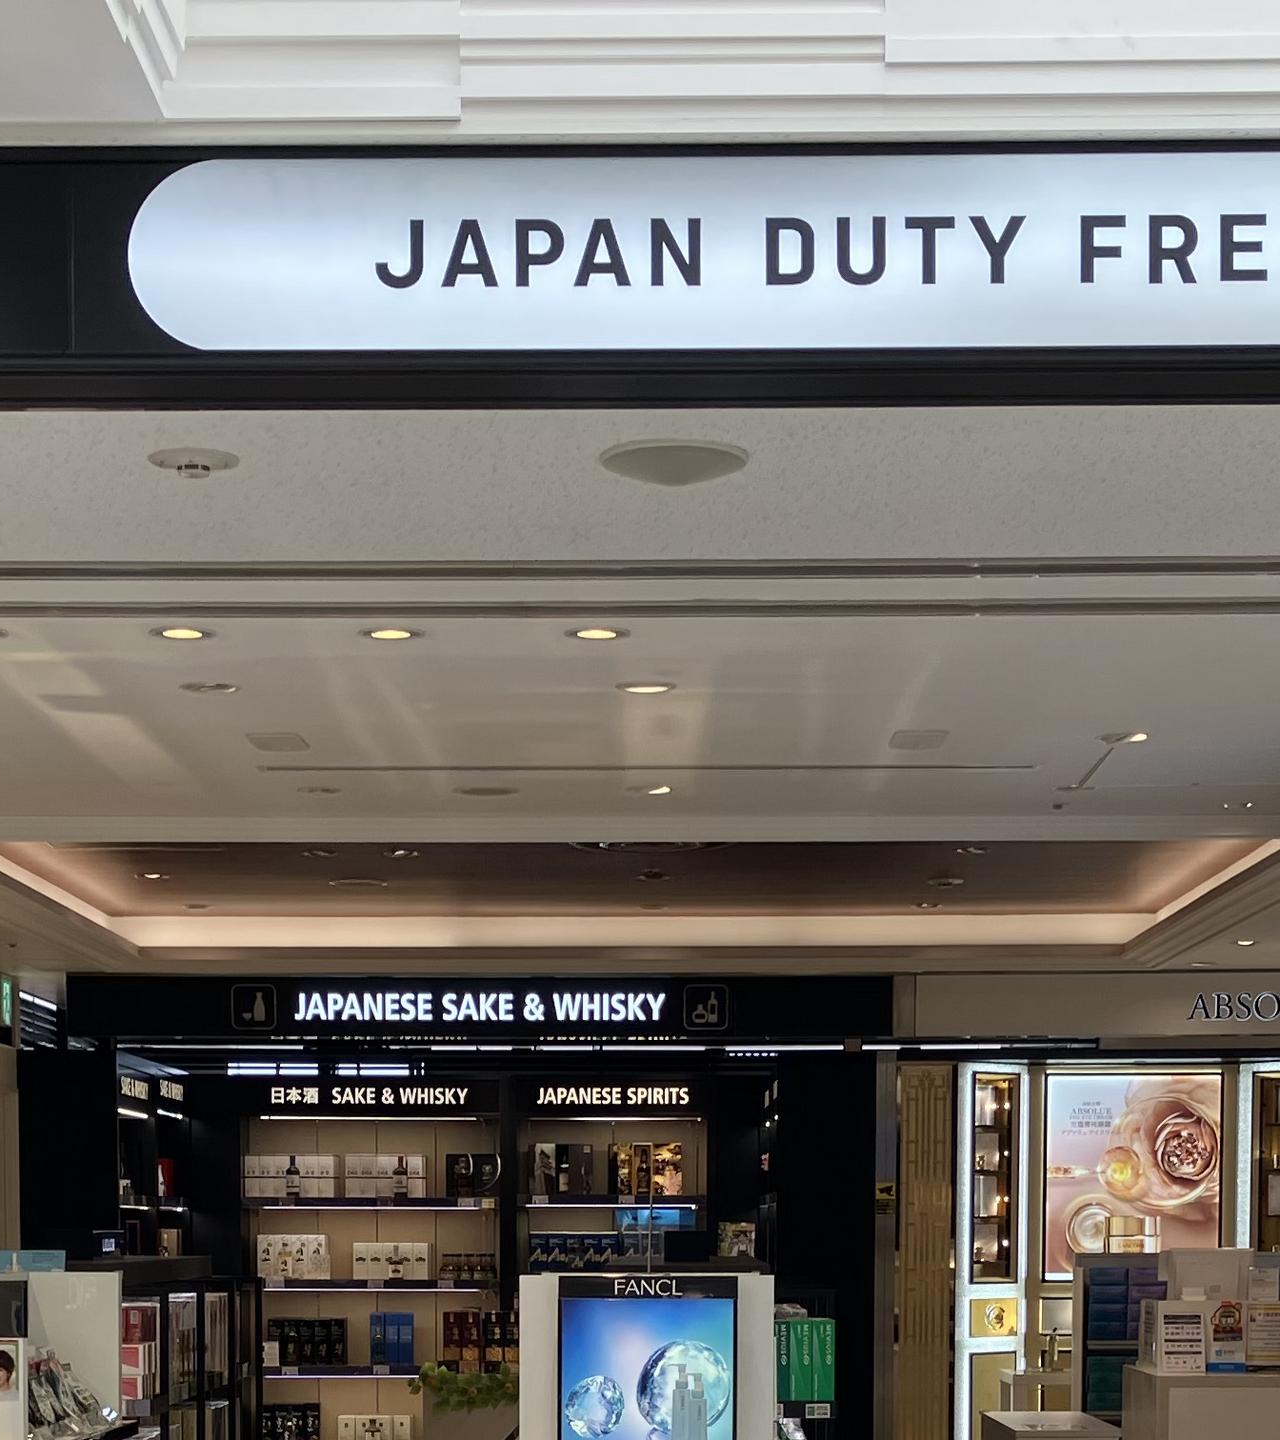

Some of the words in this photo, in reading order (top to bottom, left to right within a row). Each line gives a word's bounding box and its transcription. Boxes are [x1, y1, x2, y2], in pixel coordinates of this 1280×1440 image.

[375, 219, 705, 287] JAPAN
[764, 215, 1028, 285] DUTY
[294, 993, 433, 1022] JAPANESE
[442, 993, 514, 1022] SAKE
[523, 993, 546, 1022] &
[552, 993, 666, 1022] WHISKY
[270, 1087, 319, 1105] 日本酒
[332, 1087, 376, 1105] SAKE
[381, 1087, 395, 1105] &
[399, 1087, 468, 1105] WHISKY
[537, 1087, 621, 1105] JAPANESE
[627, 1087, 689, 1105] SPIRITS
[614, 1279, 683, 1297] FANCL
